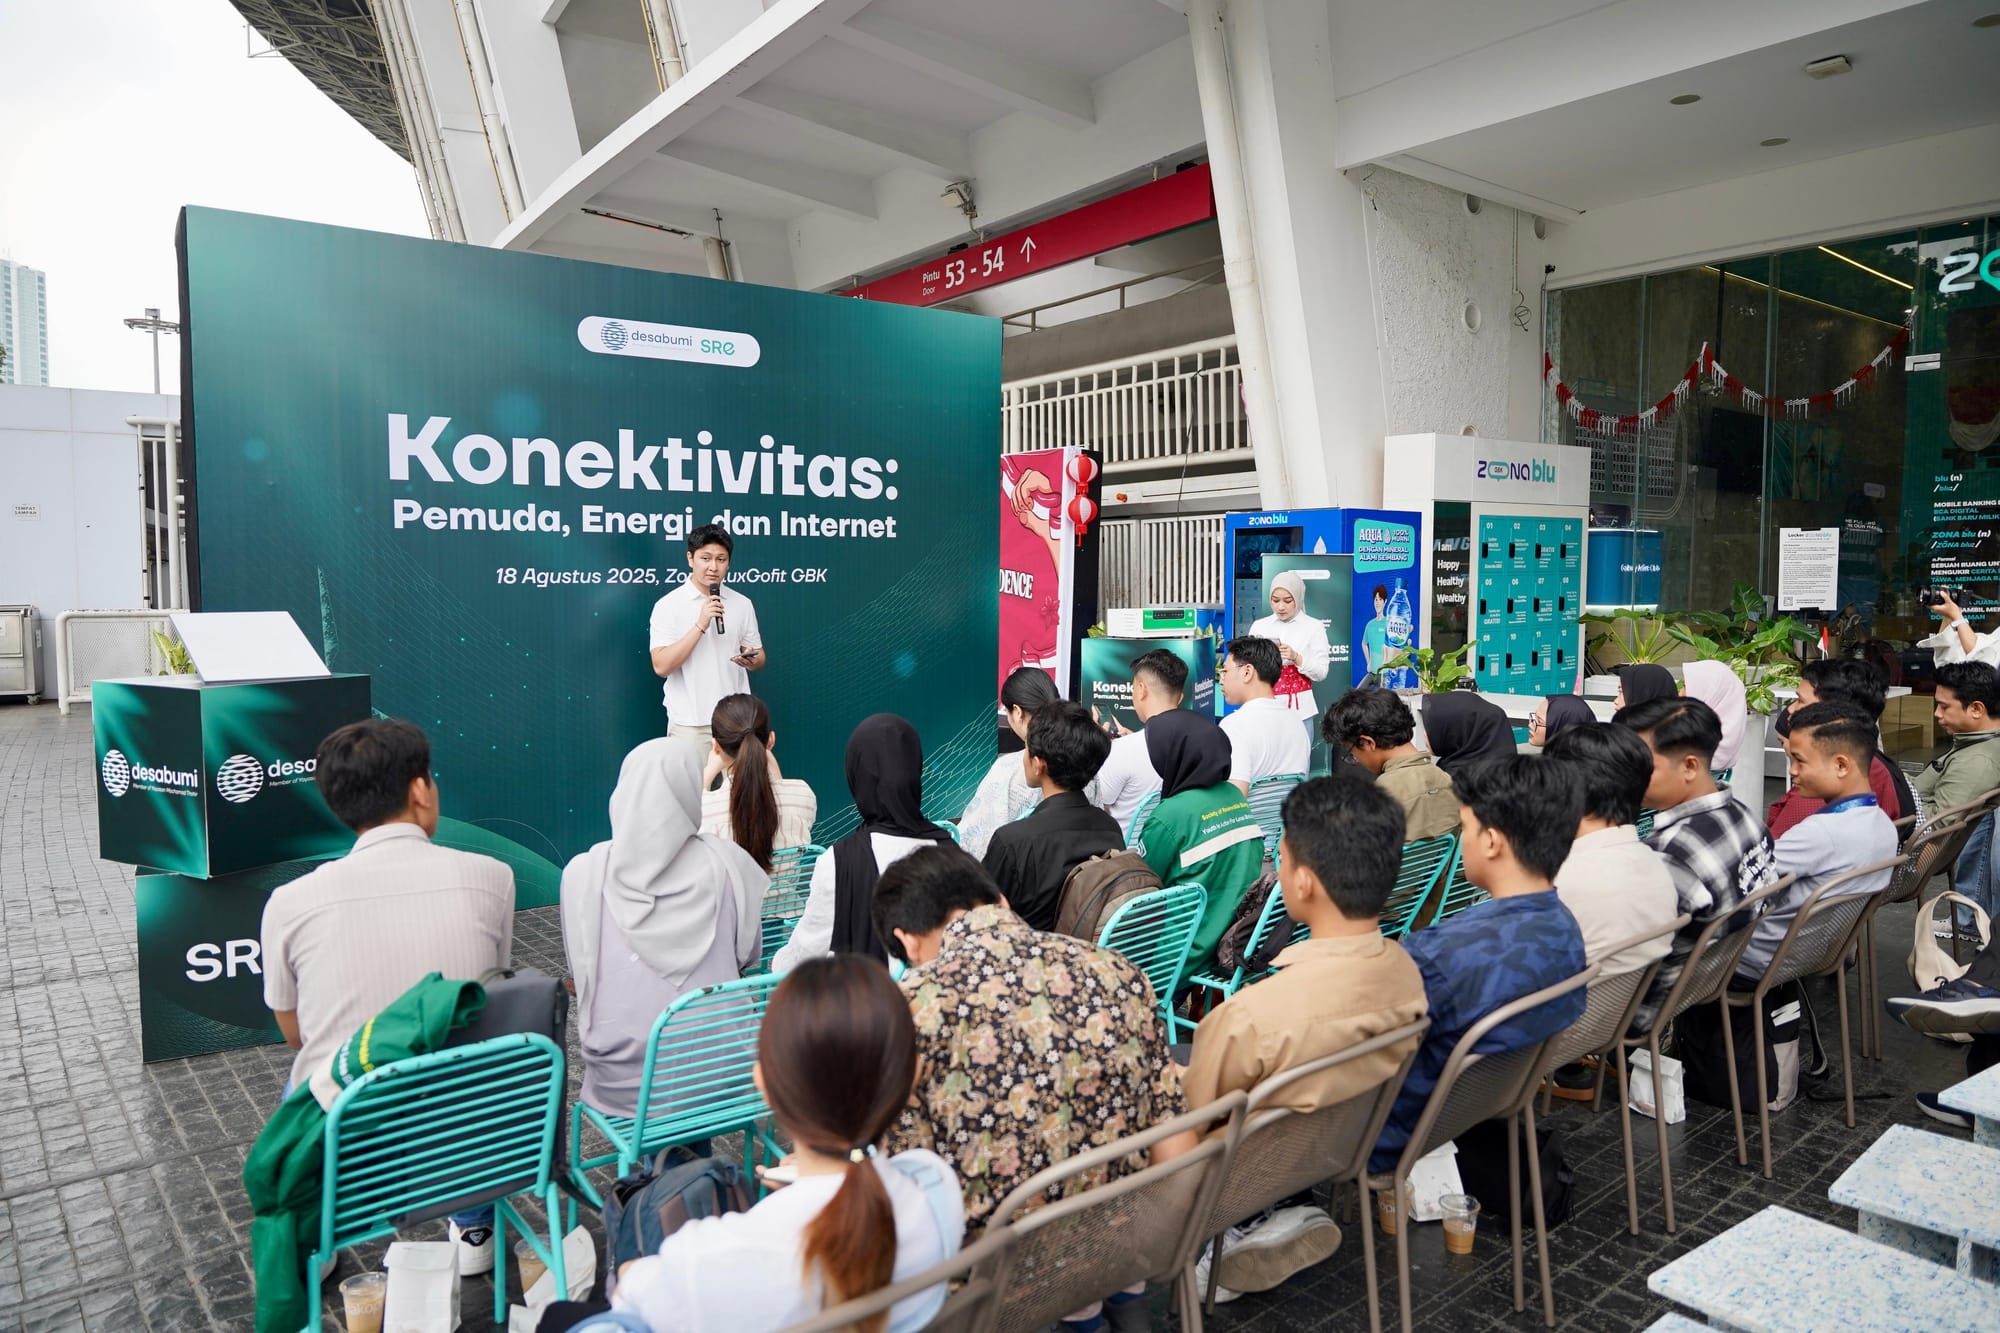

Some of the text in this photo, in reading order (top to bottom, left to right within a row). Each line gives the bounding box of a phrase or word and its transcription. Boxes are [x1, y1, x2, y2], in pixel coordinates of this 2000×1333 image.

[945, 259, 965, 289] 53
[983, 246, 1005, 278] 54
[922, 270, 941, 284] Pintu
[922, 286, 936, 296] Door
[631, 331, 693, 347] desabumi
[388, 413, 899, 500] Konektivitas:
[1950, 473, 1963, 482] (n)
[394, 499, 897, 541] Pemuda, Energi dan Internet
[1360, 528, 1382, 544] AQUA
[1977, 529, 1991, 538] (n)
[1437, 560, 1460, 571] Happy
[496, 568, 517, 584] 18
[521, 568, 601, 588] Agustus
[606, 568, 660, 586] 2025,
[791, 567, 828, 583] GBK
[1436, 576, 1465, 588] Healthy
[1511, 578, 1519, 586] 06
[1436, 593, 1467, 605] Wealthy
[1389, 621, 1408, 636] AQUA
[131, 762, 198, 788] desabumi
